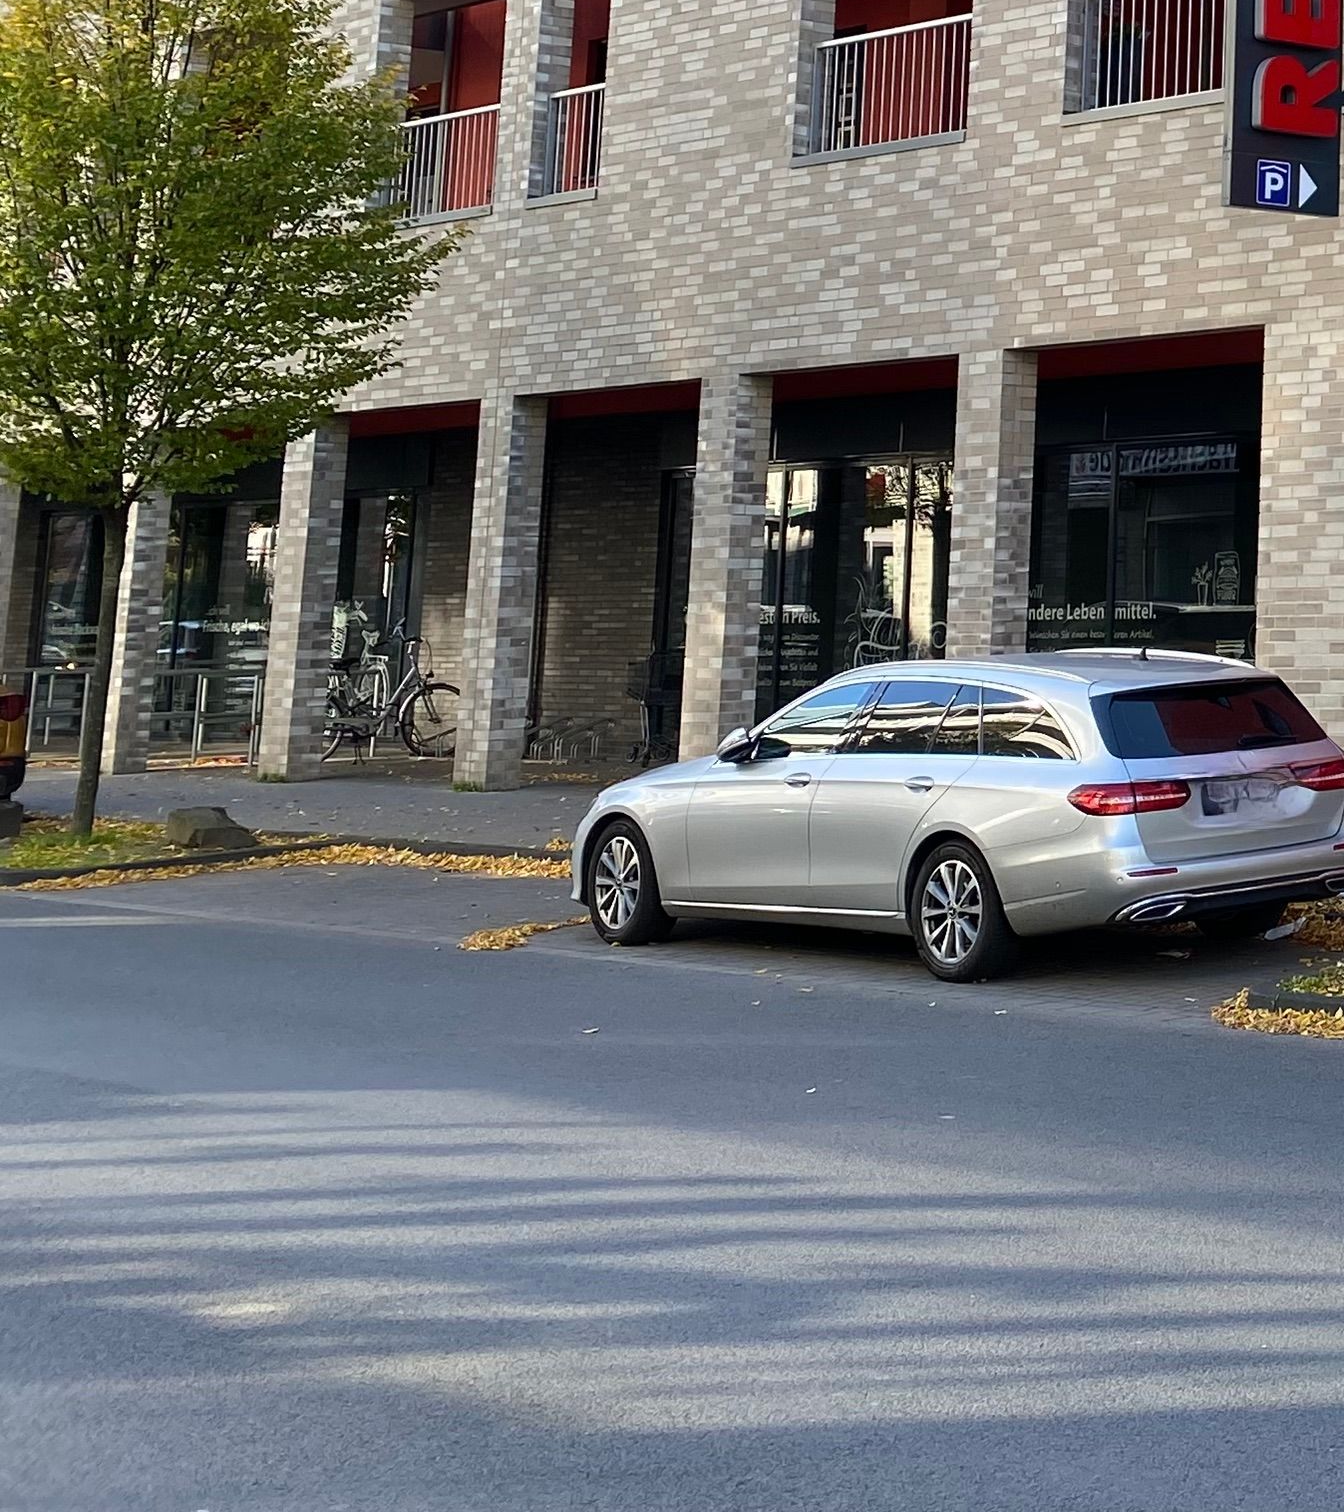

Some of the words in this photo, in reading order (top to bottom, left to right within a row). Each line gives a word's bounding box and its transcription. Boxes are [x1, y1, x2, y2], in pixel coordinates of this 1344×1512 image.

[1264, 172, 1284, 199] P
[1029, 603, 1063, 620] ndere
[1066, 603, 1157, 620] Lebenmittel.
